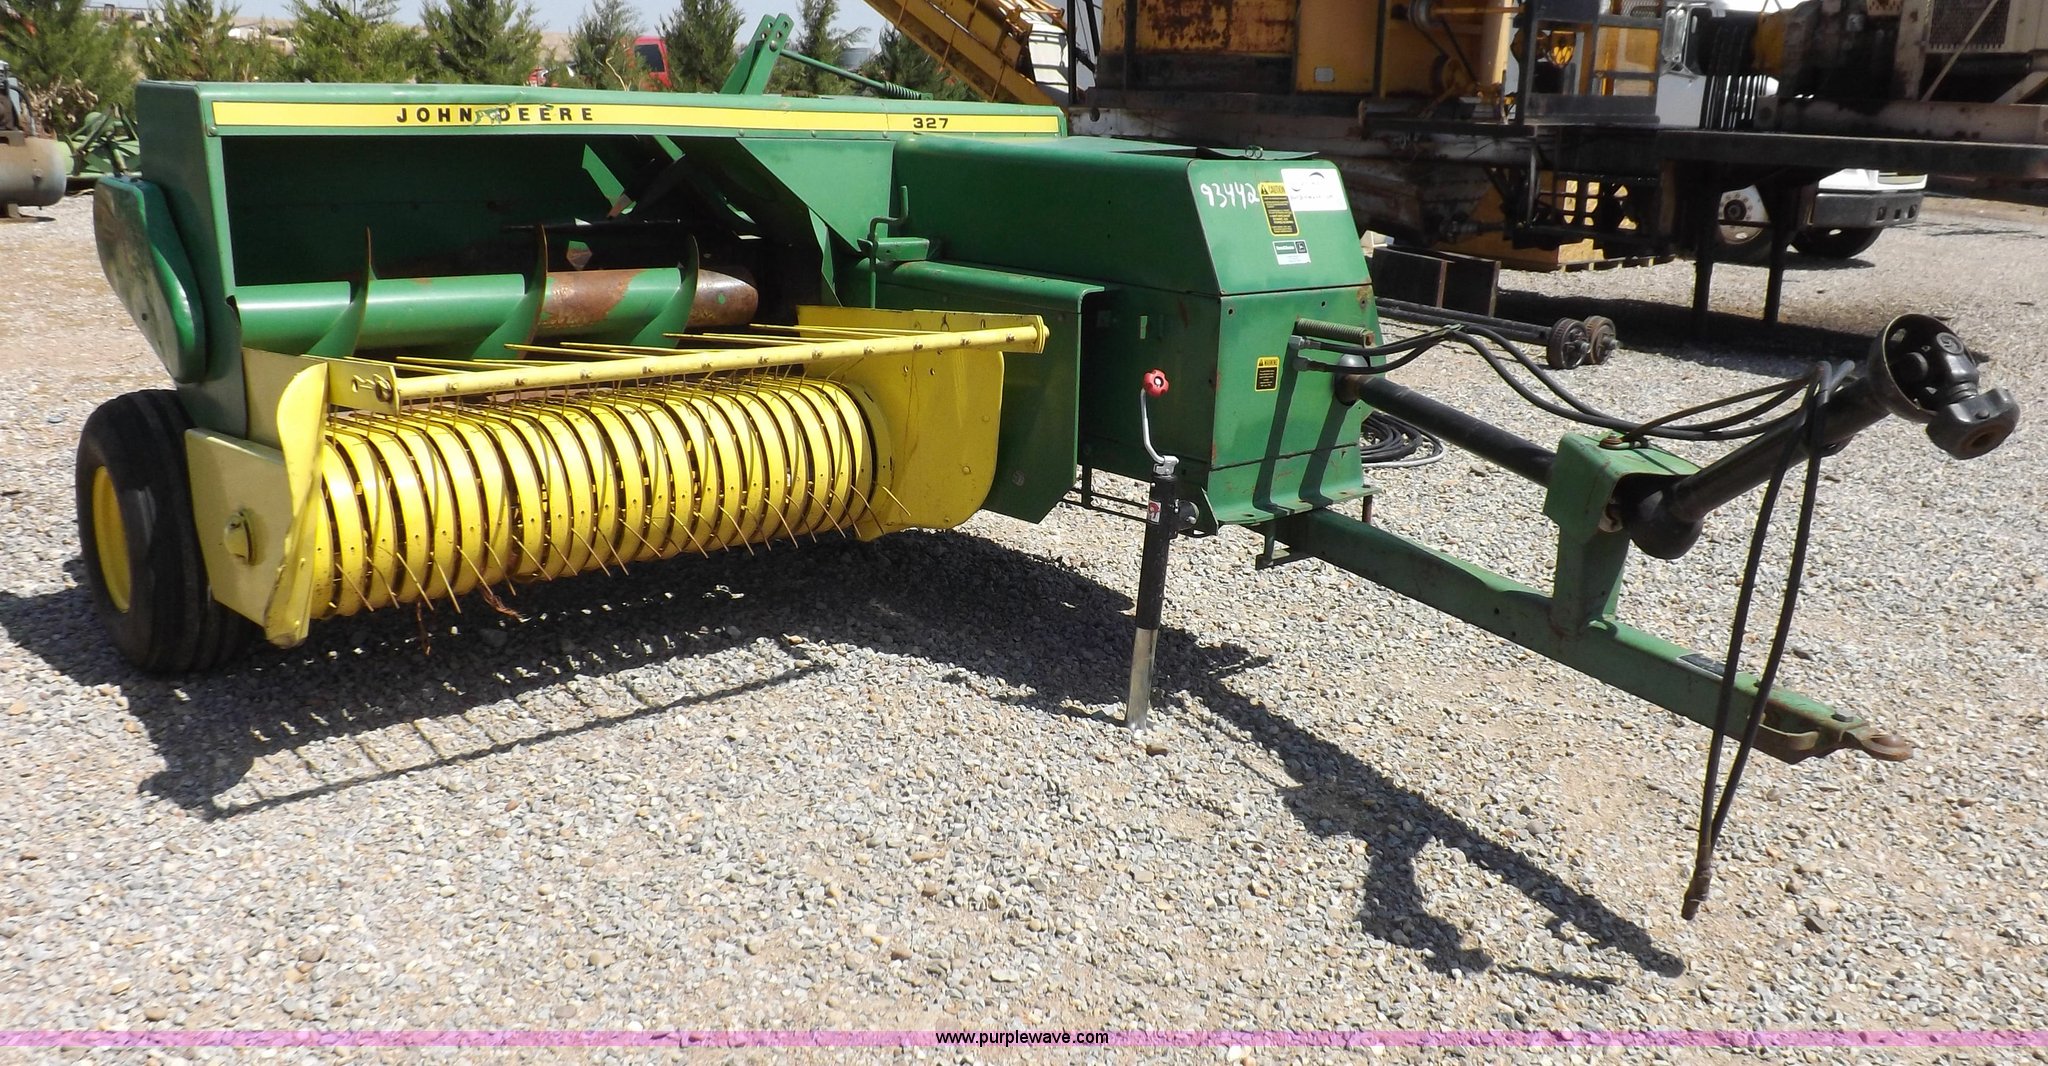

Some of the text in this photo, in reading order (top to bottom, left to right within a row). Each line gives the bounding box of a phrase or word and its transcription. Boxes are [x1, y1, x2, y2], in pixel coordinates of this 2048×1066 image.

[396, 107, 593, 122] JOHN DEERE
[912, 117, 949, 129] 327
[1200, 181, 1260, 209] 93442
